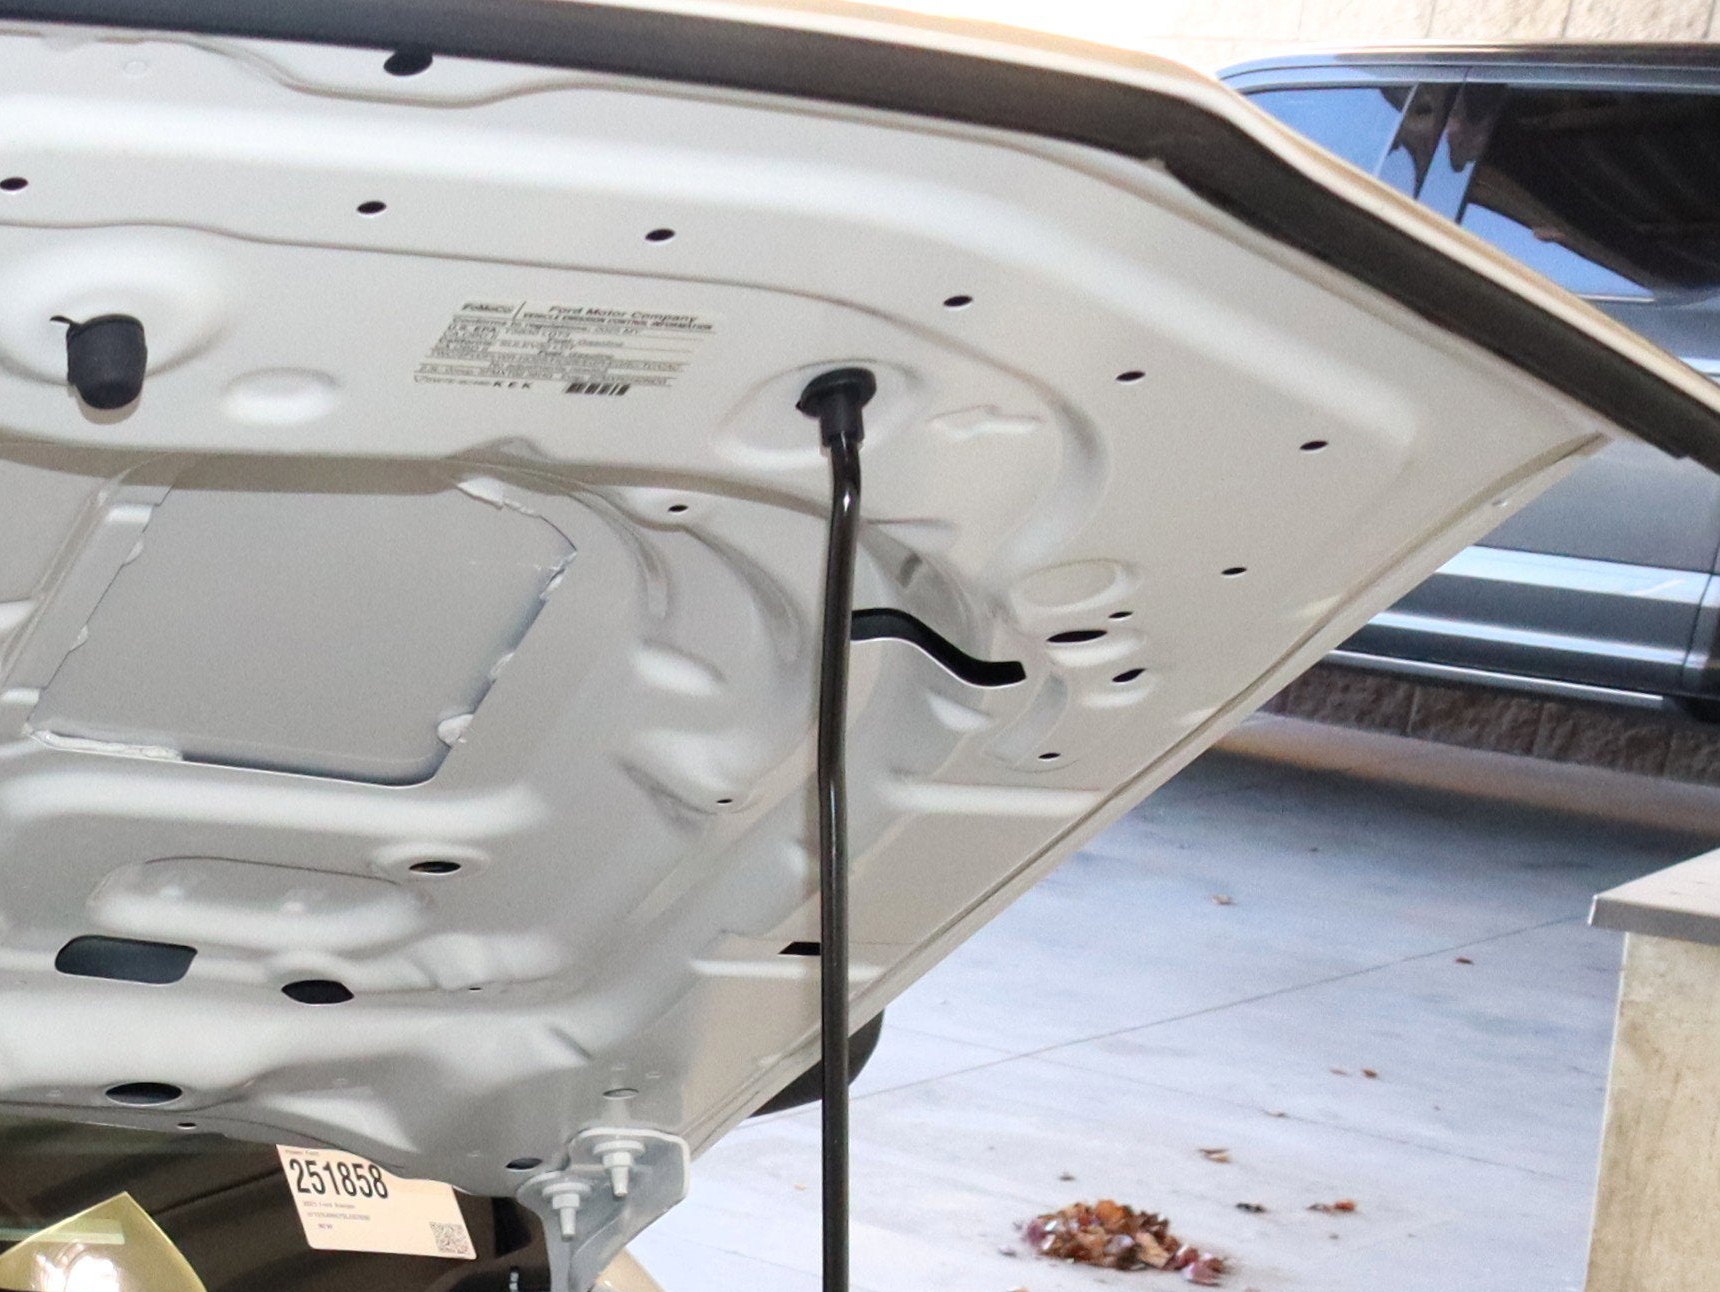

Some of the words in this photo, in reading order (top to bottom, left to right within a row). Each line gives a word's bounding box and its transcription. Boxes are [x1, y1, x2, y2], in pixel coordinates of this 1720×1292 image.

[549, 305, 584, 315] Ford
[586, 308, 626, 318] Motor
[630, 311, 699, 323] Company
[289, 1158, 388, 1199] 251858
